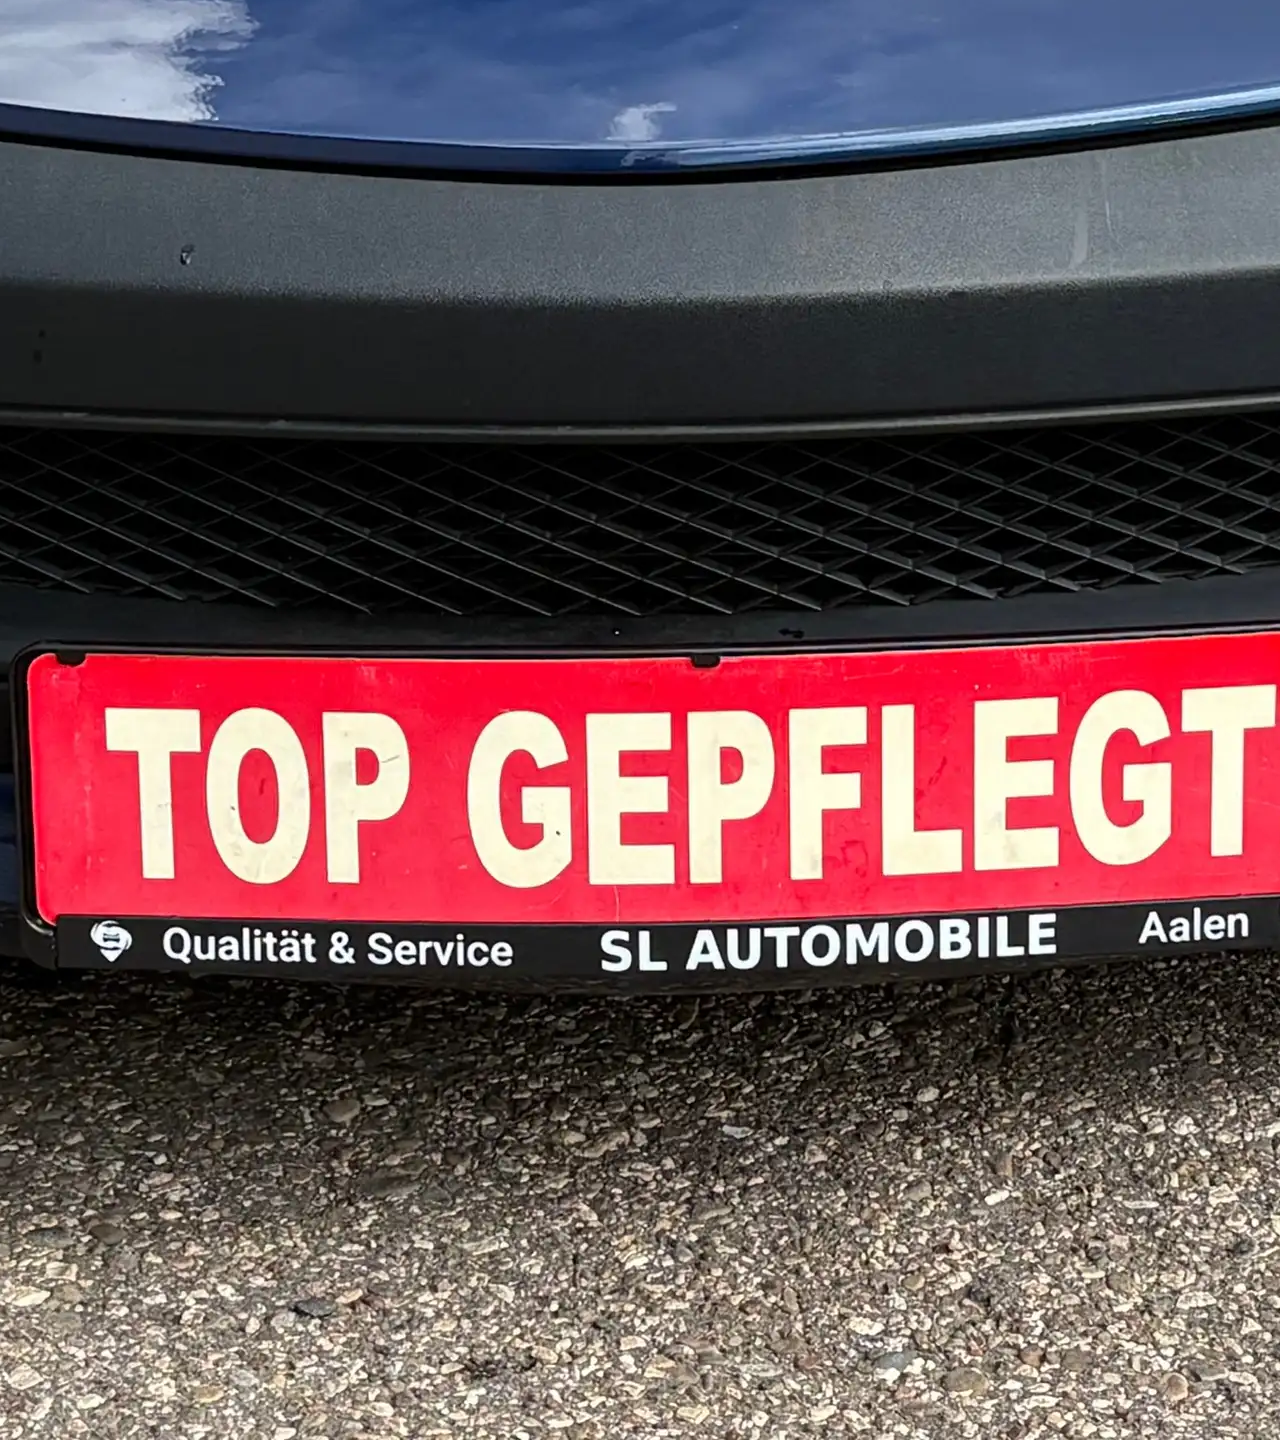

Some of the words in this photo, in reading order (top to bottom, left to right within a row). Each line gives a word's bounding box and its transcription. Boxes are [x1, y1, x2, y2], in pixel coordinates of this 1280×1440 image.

[104, 707, 410, 884] TOP
[162, 926, 317, 965] Qualität
[328, 930, 356, 964] &
[367, 931, 514, 967] Service
[600, 929, 668, 972] SL
[685, 912, 1057, 971] AUTOMOBILE
[1138, 906, 1249, 944] Aalen
